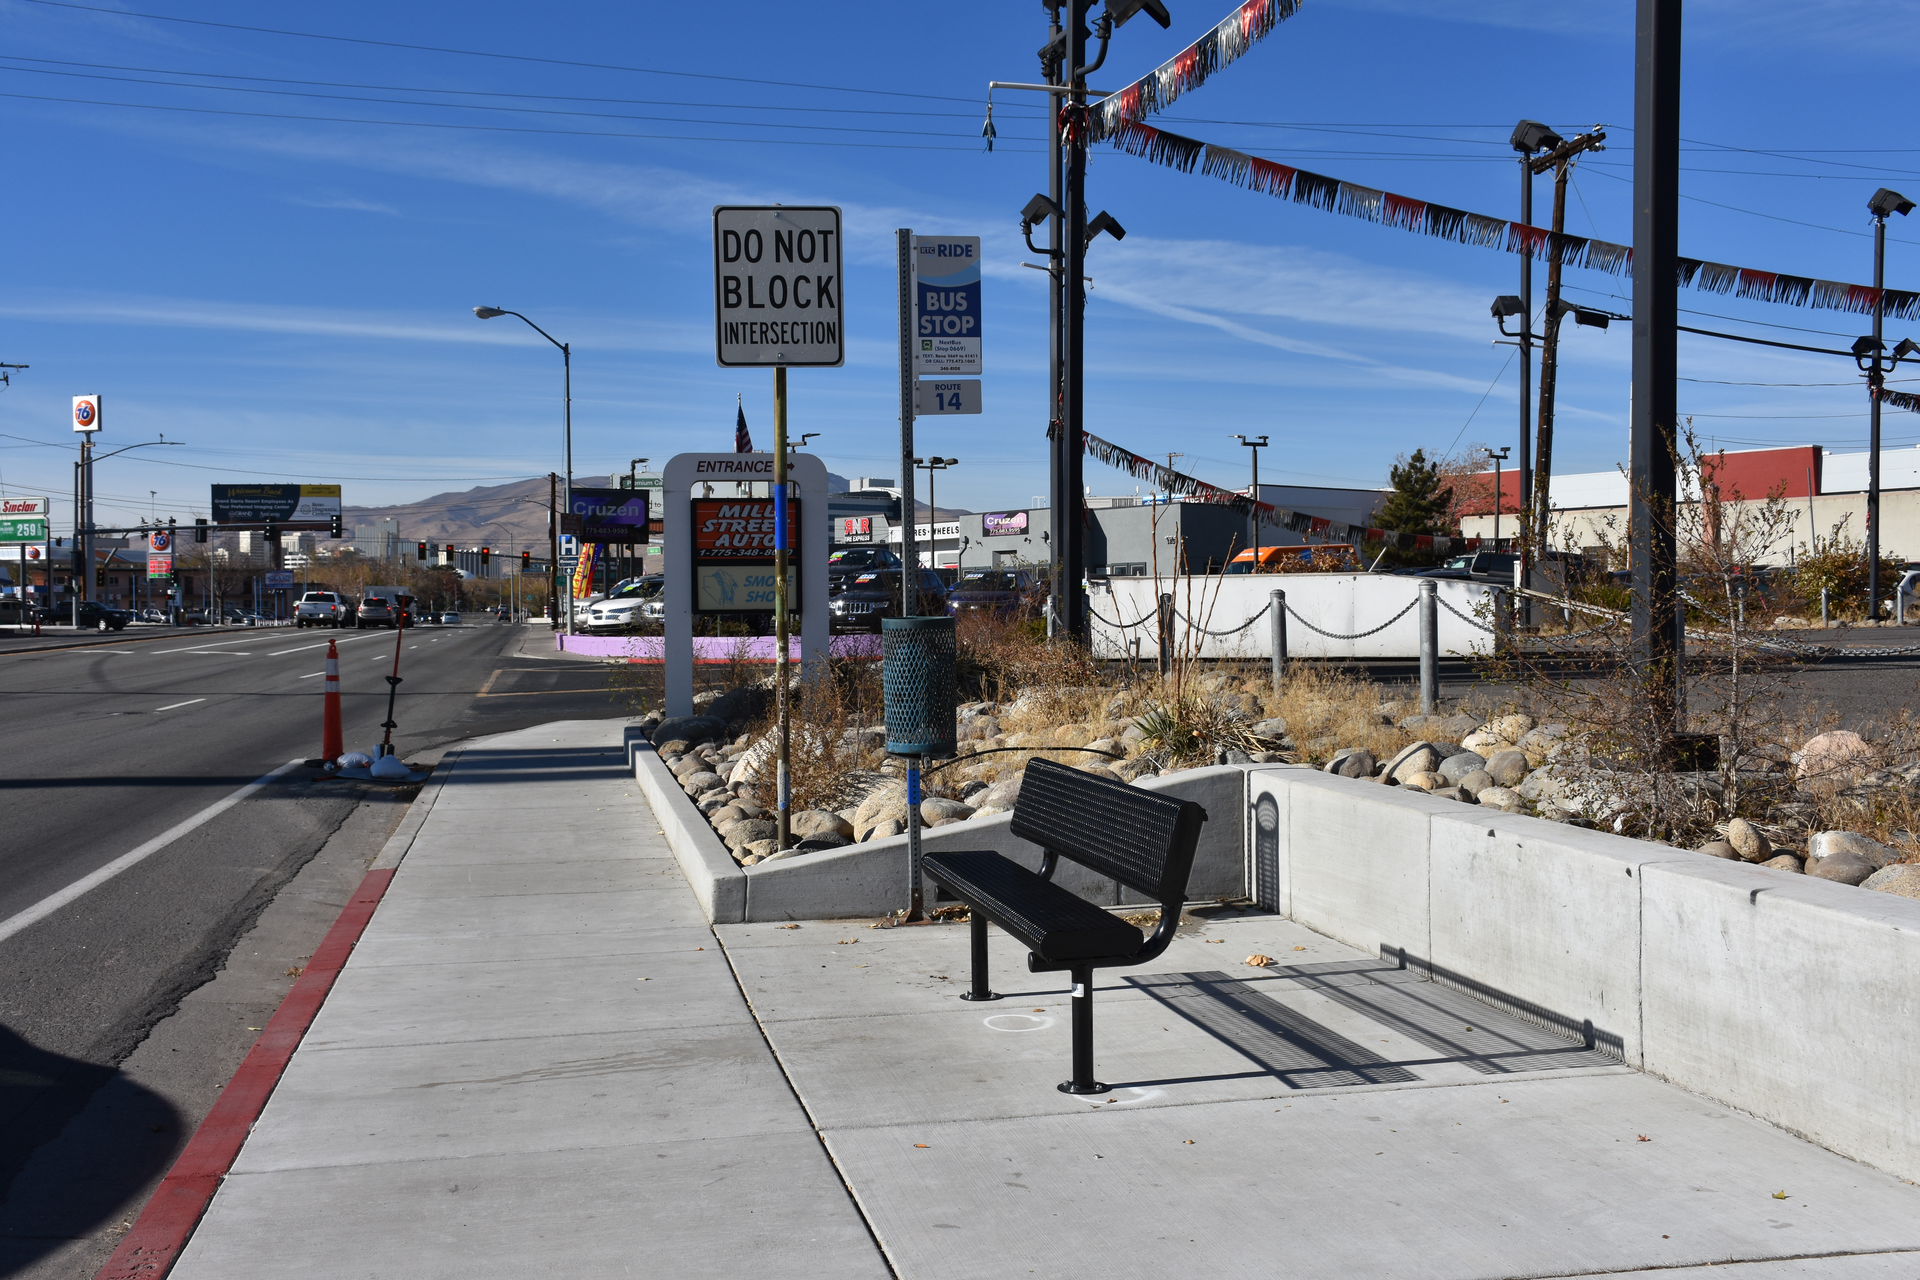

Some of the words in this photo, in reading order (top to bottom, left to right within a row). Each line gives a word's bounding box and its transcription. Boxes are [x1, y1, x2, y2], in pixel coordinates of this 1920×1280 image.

[723, 229, 763, 263] DO
[774, 229, 834, 263] NOT
[938, 244, 972, 257] RIDE
[723, 275, 835, 309] BLOCK
[926, 292, 967, 311] BUS
[920, 315, 974, 334] STOP
[724, 321, 836, 344] INTERSECTION
[936, 392, 962, 410] 14
[77, 405, 91, 420] 76
[696, 460, 774, 473] ENTRANCE
[227, 487, 261, 497] Welcome
[263, 486, 282, 495] Back
[2, 500, 38, 512] Sinclair
[573, 502, 638, 516] Cruzen
[718, 504, 776, 517] MILL
[986, 516, 1023, 525] Cruzen
[17, 524, 36, 536] 259
[154, 535, 166, 546] 76
[561, 536, 576, 555] H
[714, 534, 776, 547] AUTO
[744, 576, 793, 587] SMOE
[746, 591, 776, 602] SHO
